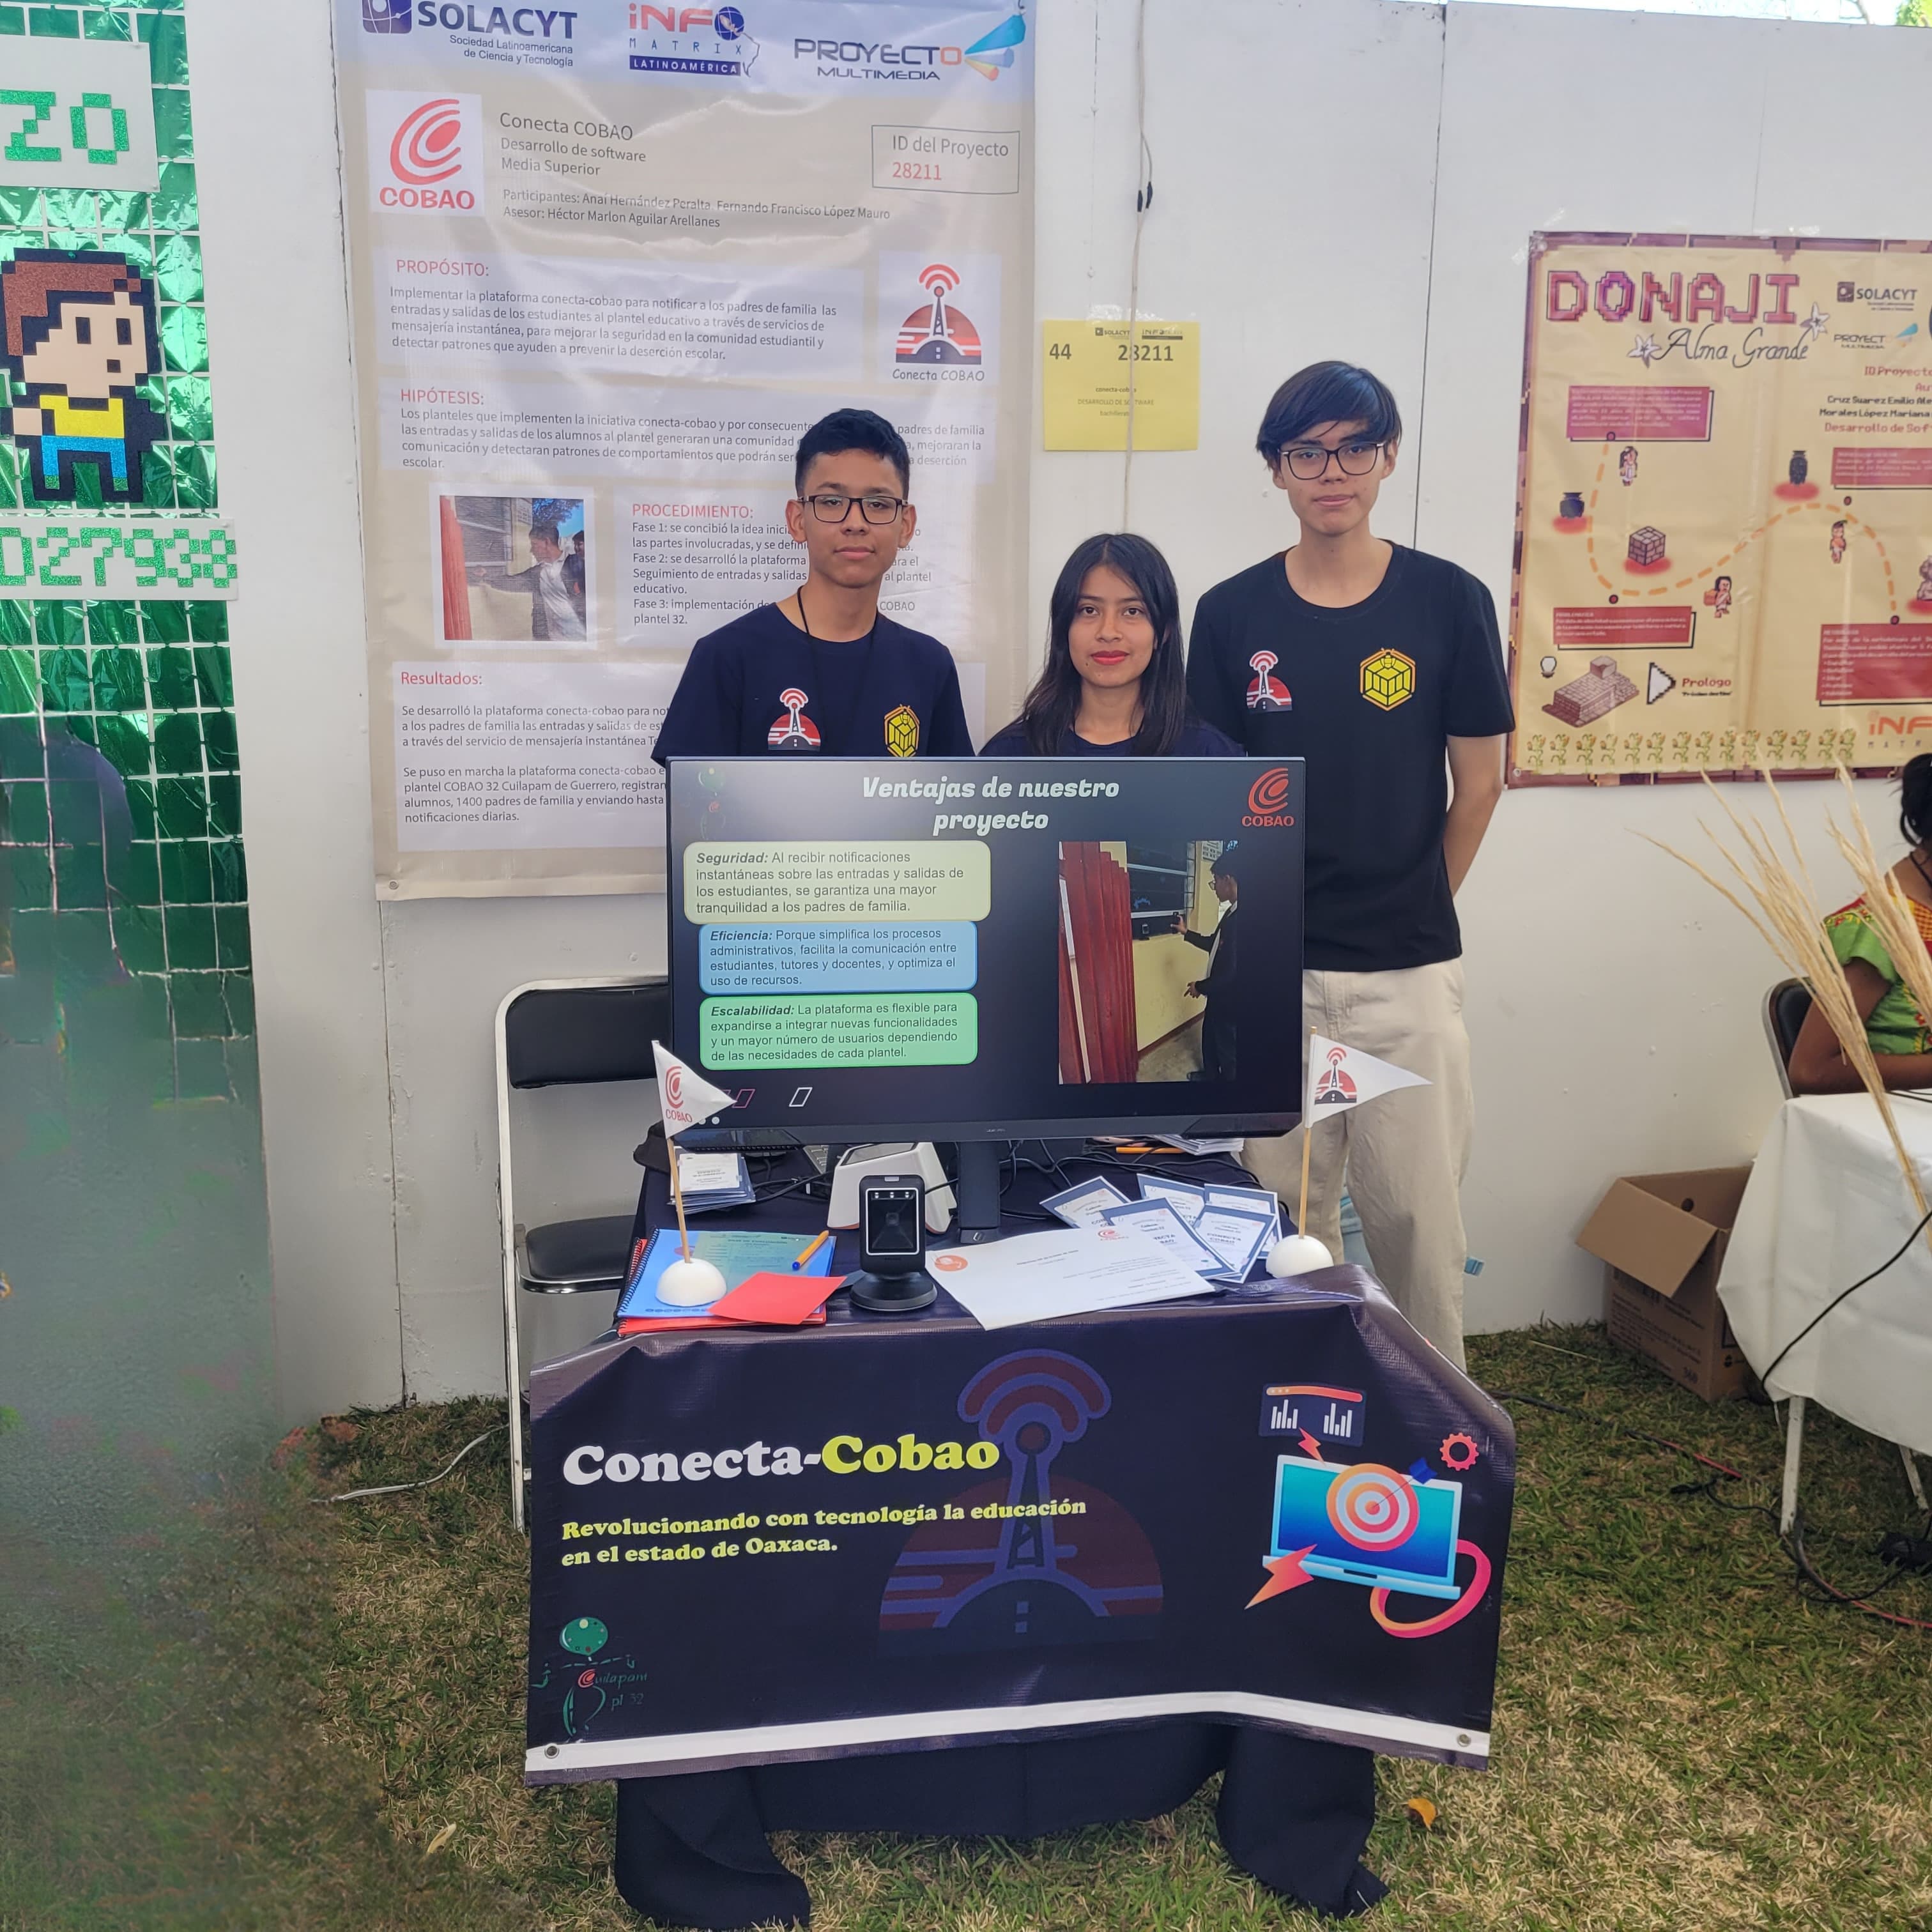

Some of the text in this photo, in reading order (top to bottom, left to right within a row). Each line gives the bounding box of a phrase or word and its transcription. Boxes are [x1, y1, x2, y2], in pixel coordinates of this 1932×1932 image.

[417, 1, 578, 39] SOLACYT
[450, 34, 572, 54] Sociedad Latinoamericana
[794, 38, 962, 66] PROYECTO
[464, 48, 572, 68] de Ciencia y Tecnología
[634, 58, 737, 73] LATINOAMÉRICA
[817, 66, 940, 80] MULTIMEDIA
[500, 112, 632, 141] Conecta COBAO
[502, 137, 646, 162] Desarrollo de software
[893, 134, 1008, 159] ID del Proyecto
[502, 157, 600, 176] Media Superior
[892, 162, 942, 181] 28211
[379, 187, 475, 210] COBAO
[504, 189, 579, 204] Participantes:
[583, 193, 607, 205] Anaí
[610, 195, 670, 208] Hernández
[717, 201, 768, 213] Fernando
[772, 203, 821, 216] Francisco
[824, 204, 855, 220] López
[858, 207, 889, 219] Mauro
[504, 206, 720, 227] Asesor: Héctor Marlon Aguilar Arellanes
[397, 258, 489, 277] PROPÓSITO:
[390, 286, 836, 316] Implementar la plataforma conecta-cobao para notificar a los padres de familia las
[1546, 270, 1800, 324] DONAJI
[1857, 288, 1917, 300] SOLACYT
[1049, 344, 1174, 362] 44 28211
[1653, 324, 1813, 369] Alma Grande
[892, 369, 985, 381] Conecta COBAO
[401, 386, 484, 405] HIPÓTESIS:
[1827, 395, 1850, 404] Cruz
[1825, 422, 1888, 433] Desarrollo
[1890, 423, 1905, 433] de
[633, 504, 753, 519] PROCEDIMIENTO:
[634, 568, 808, 583] Seguimiento de entradas y salidas
[885, 571, 931, 583] al plantel
[634, 583, 687, 594] educativo.
[880, 602, 916, 611] COBAO
[634, 613, 687, 626] plantel 32.
[401, 671, 482, 685] Resultados:
[862, 776, 1120, 804] Ventajas de nuestro
[405, 794, 663, 809] alumnos, 1400 padres de familia y enviando hasta
[932, 811, 1049, 836] proyecto
[1241, 815, 1294, 827] COBAO
[697, 852, 910, 866] Seguridad: Al recibir notificaciones
[696, 867, 963, 881] instantáneas sobre las entradas y salidas de
[697, 884, 937, 898] los estudiantes, se garantiza una mayor
[696, 901, 767, 916] tranquilidad
[783, 901, 800, 912] los
[805, 901, 845, 915] padres
[850, 900, 864, 911] de
[868, 900, 910, 912] familia.
[710, 929, 940, 942] Eficiencia: Porque simplifica los procesos
[666, 1109, 693, 1123] COBAO
[564, 1433, 1000, 1485] Conecta-Cobao
[562, 1498, 1086, 1540] Revolucionando con tecnología la educación
[562, 1538, 837, 1567] en el estado de Oaxaca.
